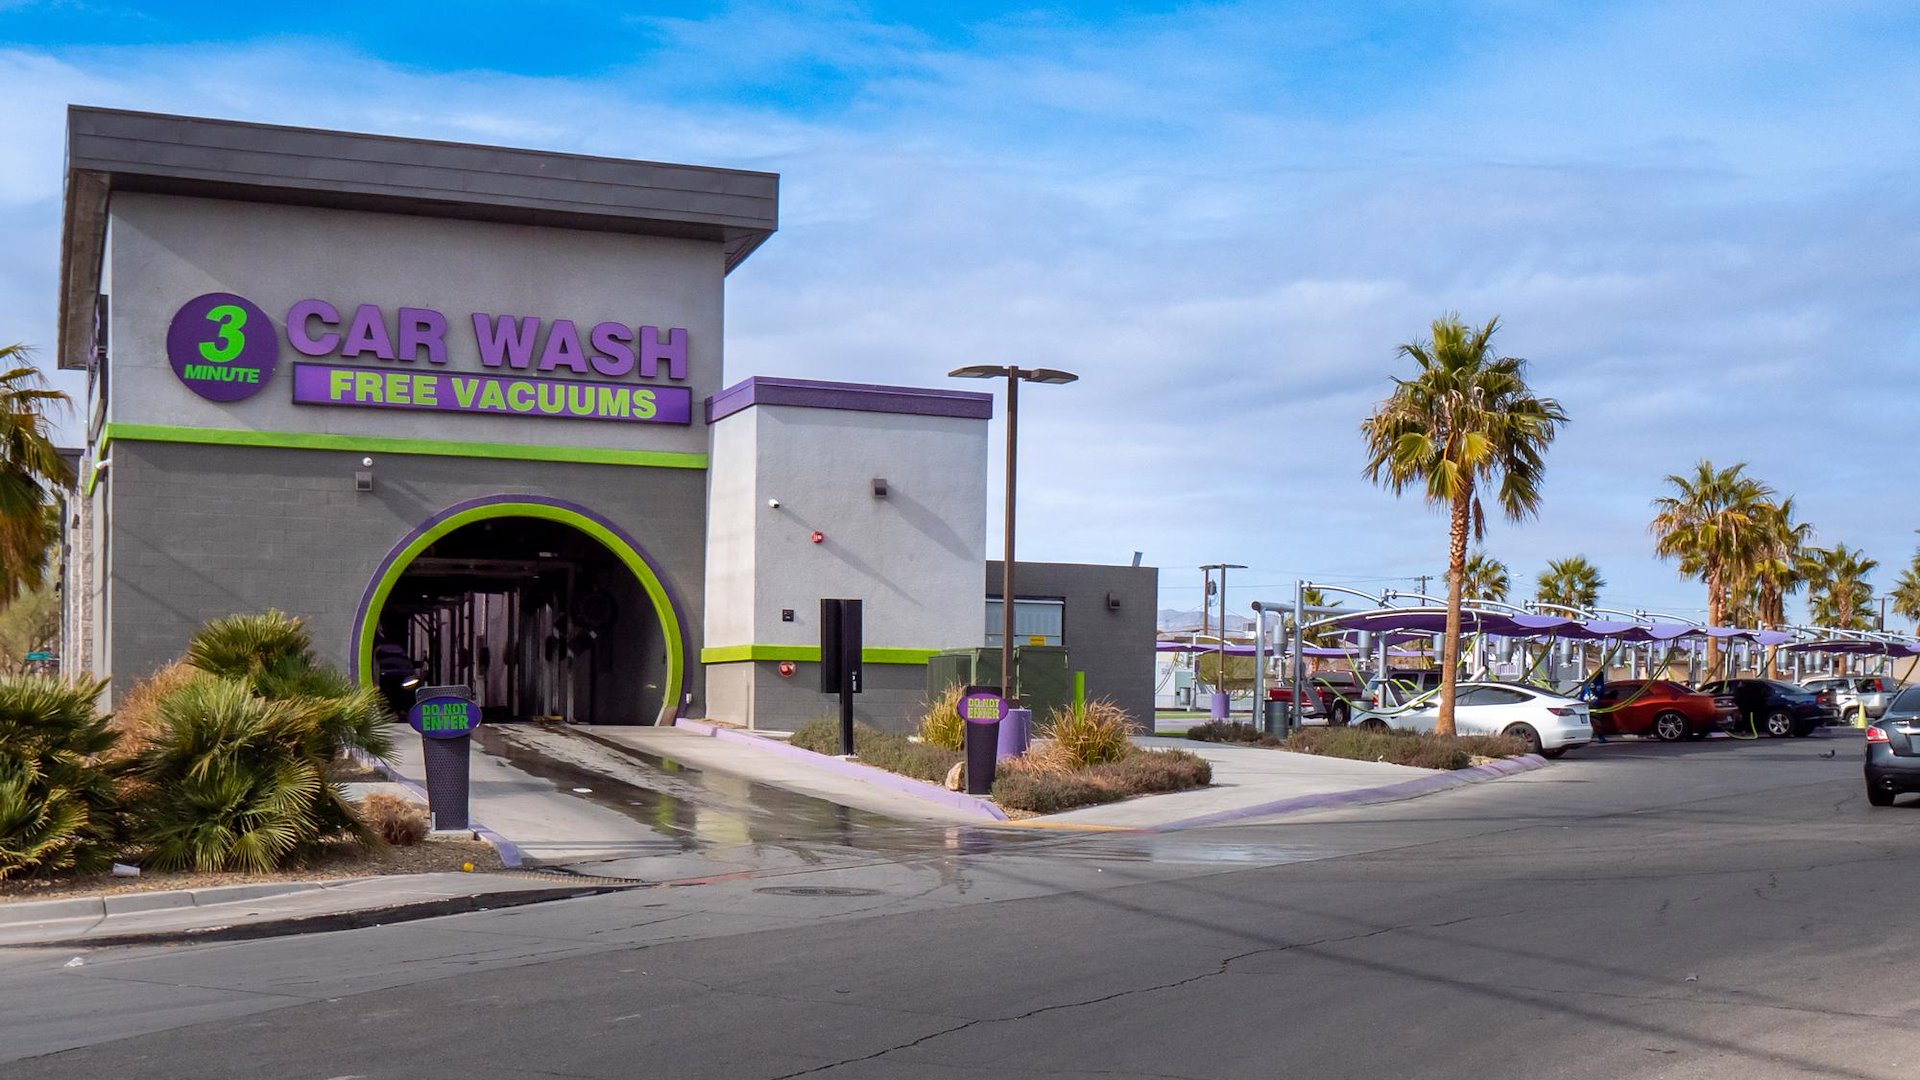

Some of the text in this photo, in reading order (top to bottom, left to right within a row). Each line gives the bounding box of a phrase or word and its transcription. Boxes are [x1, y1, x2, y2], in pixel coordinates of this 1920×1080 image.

[199, 304, 247, 363] 3
[286, 299, 688, 380] CAR WASH
[184, 364, 260, 384] MINUTE
[329, 370, 658, 419] FREE VACUUMS
[422, 703, 467, 716] DO NOT
[968, 698, 1000, 708] DO NOT
[967, 707, 1000, 719] ENTER
[422, 715, 469, 731] ENTER
